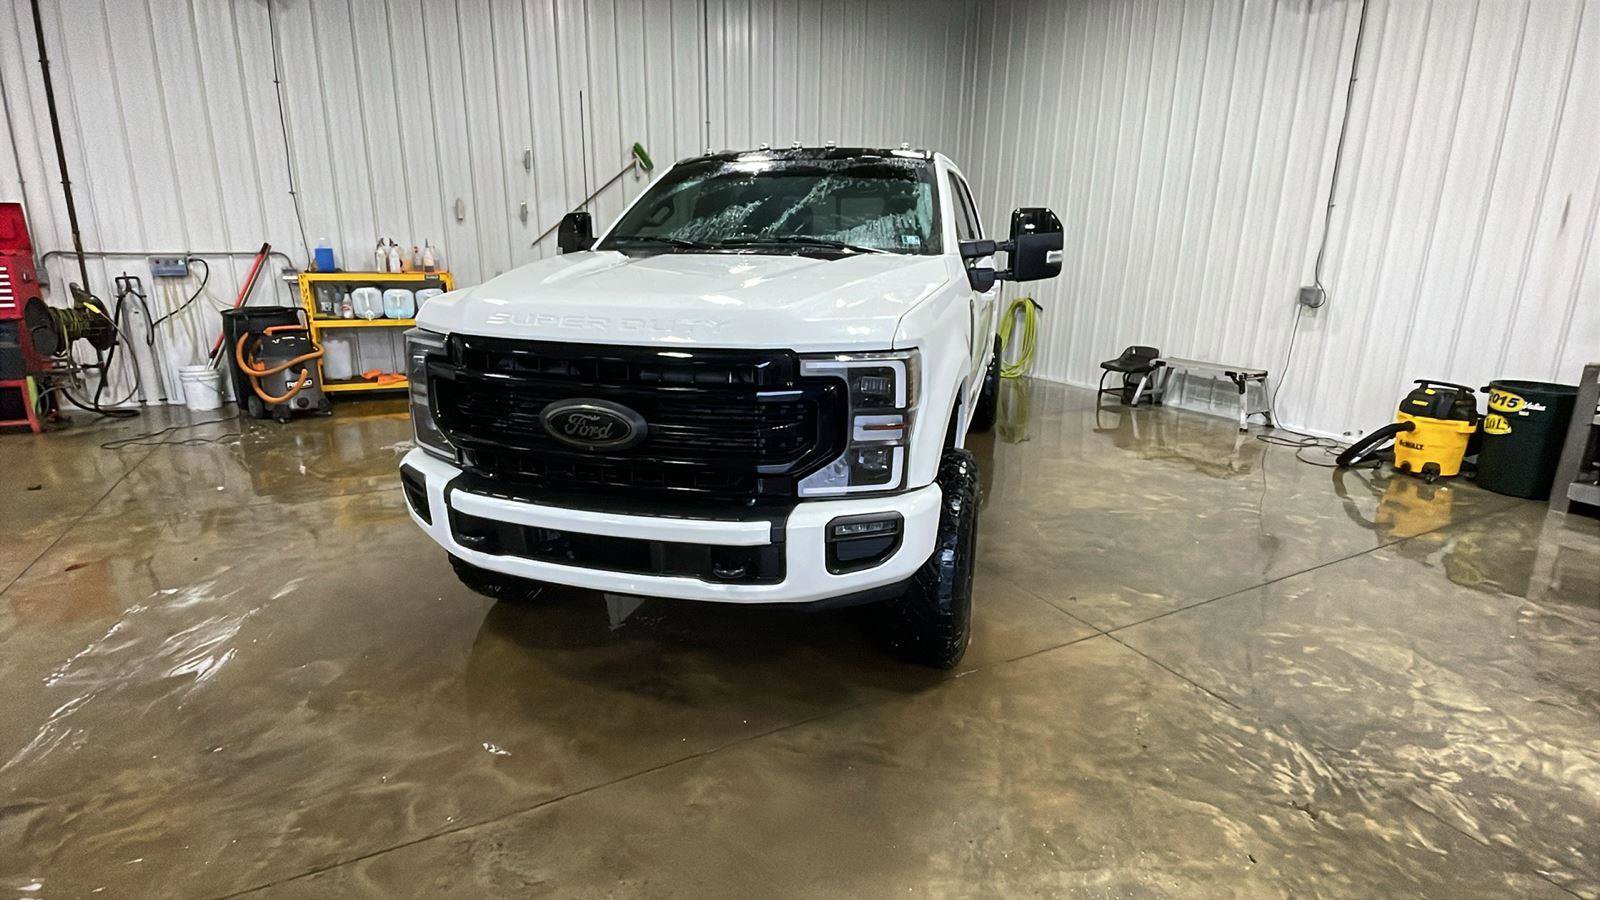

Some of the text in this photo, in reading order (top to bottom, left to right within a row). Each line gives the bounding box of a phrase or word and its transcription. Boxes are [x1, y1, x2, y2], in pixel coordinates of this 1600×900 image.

[485, 312, 733, 335] SUPER DUTY
[564, 413, 613, 440] Ford
